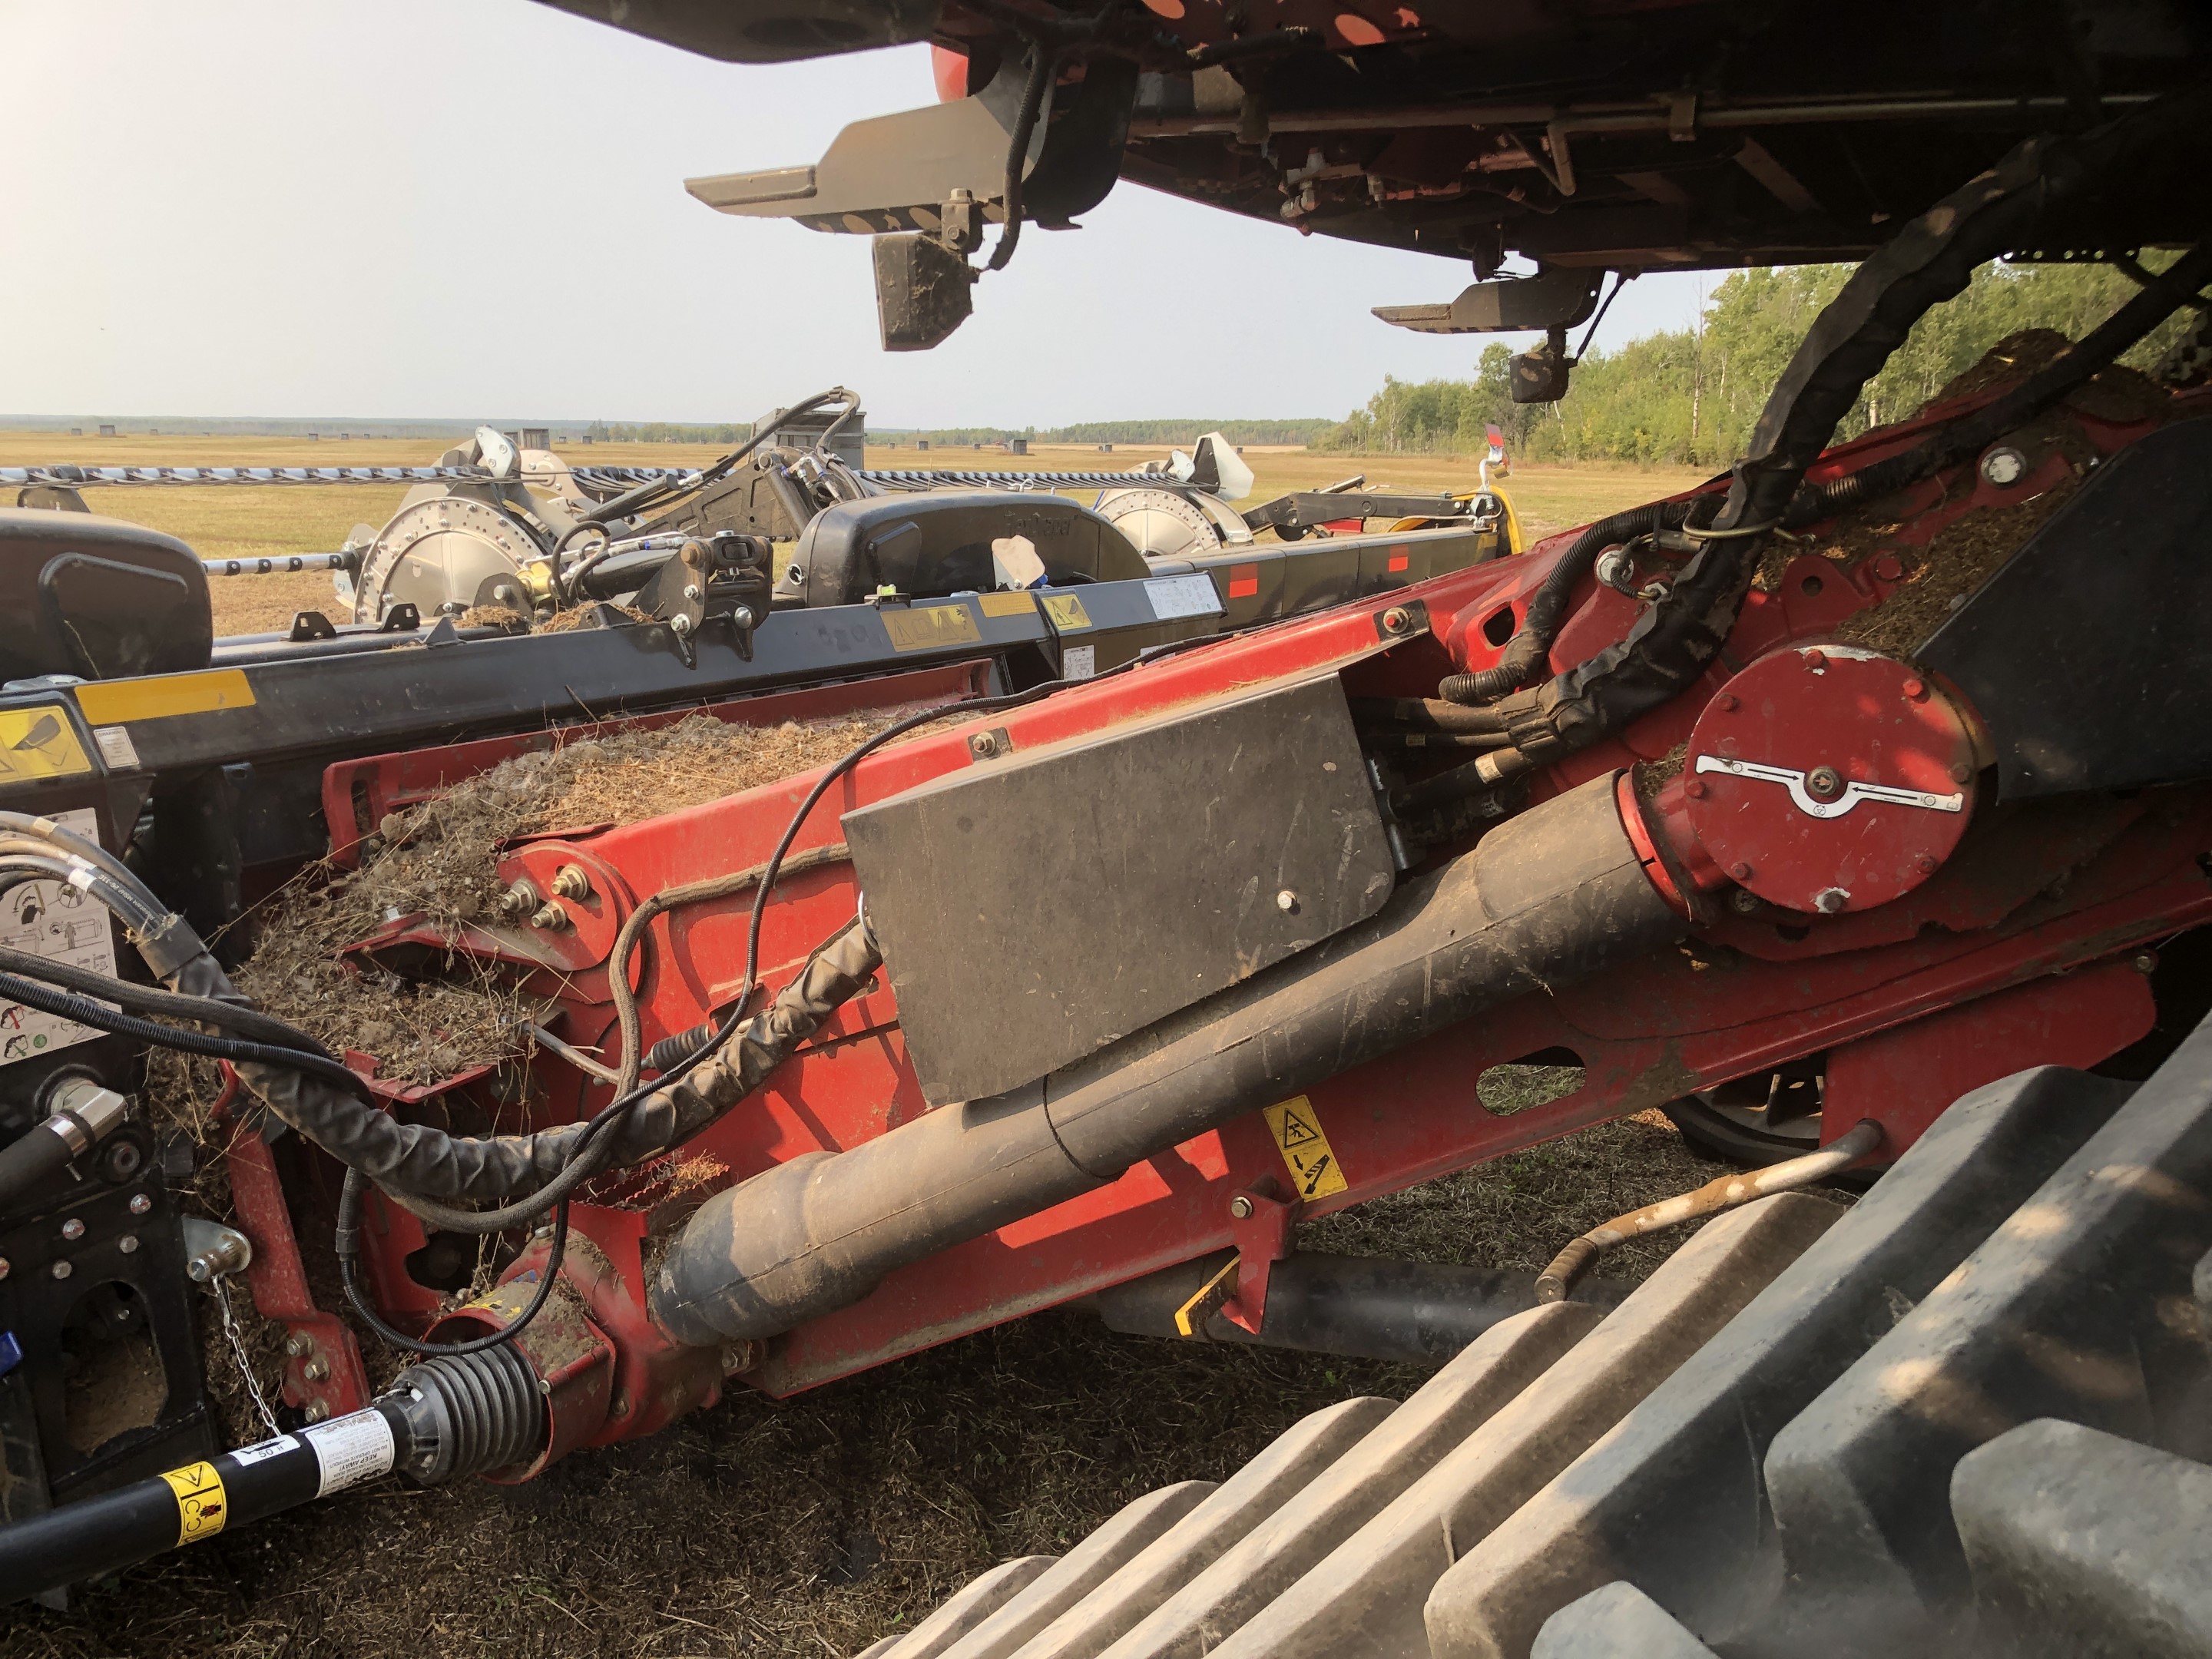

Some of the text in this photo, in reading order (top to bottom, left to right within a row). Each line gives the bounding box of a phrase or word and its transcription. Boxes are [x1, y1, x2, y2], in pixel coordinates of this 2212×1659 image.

[258, 1448, 273, 1458] 50
[350, 1451, 370, 1461] OPERATE
[339, 1453, 378, 1471] KEEP AWAY!
